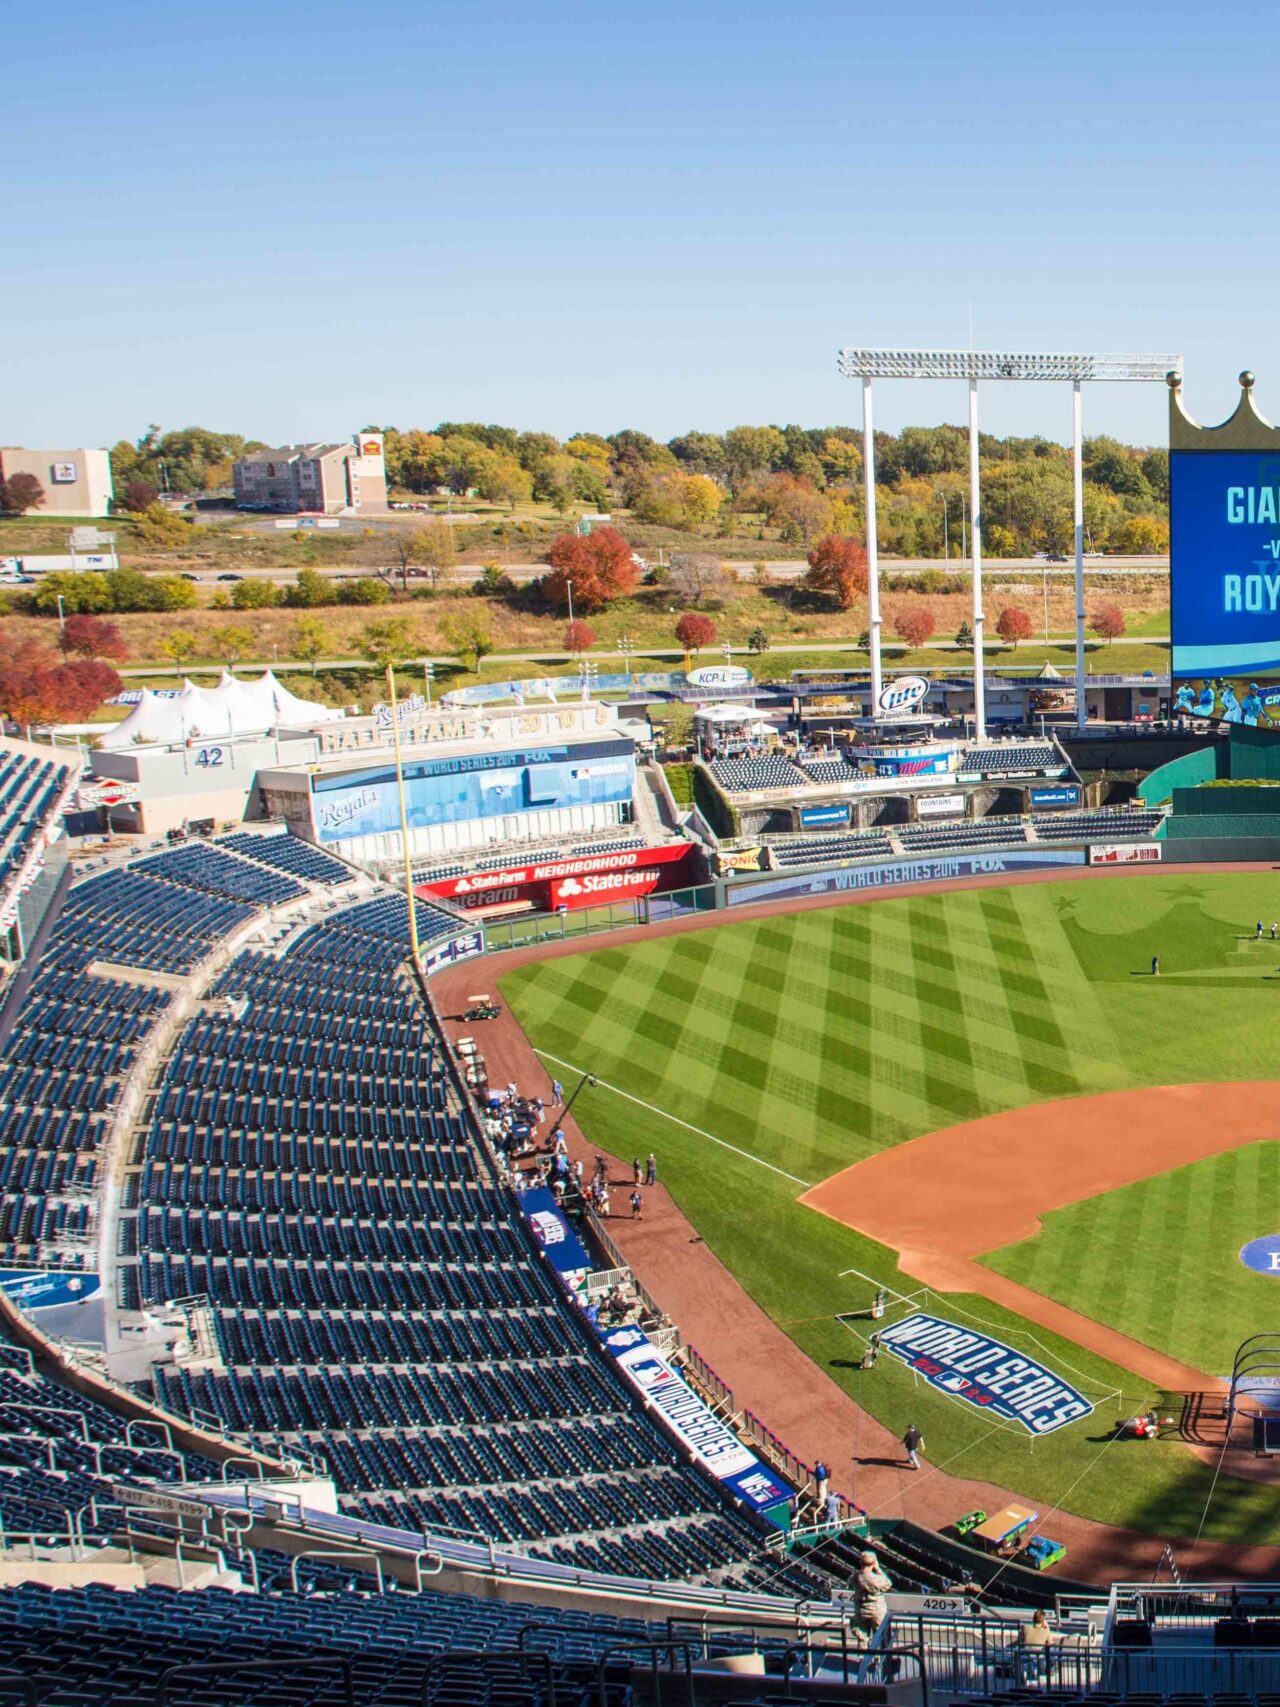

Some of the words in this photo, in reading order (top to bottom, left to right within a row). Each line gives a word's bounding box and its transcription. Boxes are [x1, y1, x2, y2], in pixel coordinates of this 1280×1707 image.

[520, 714, 542, 734] 20
[560, 710, 575, 729] 10
[195, 748, 223, 767] 42
[424, 760, 459, 777] WORLD
[460, 756, 496, 772] SERIES
[525, 752, 551, 764] FOX
[320, 789, 378, 827] Royals
[533, 853, 637, 879] NEIGHBORHOOD
[722, 854, 758, 868] SONIC
[835, 870, 884, 890] WORLD
[885, 864, 931, 884] SERIES
[931, 861, 960, 879] 2014
[970, 858, 1006, 874] FOX
[882, 1316, 993, 1371] WORLD
[976, 1351, 1093, 1430] SERIES
[646, 1378, 704, 1420] WORLD
[677, 1414, 739, 1458] SERIES
[923, 1599, 947, 1611] 420
